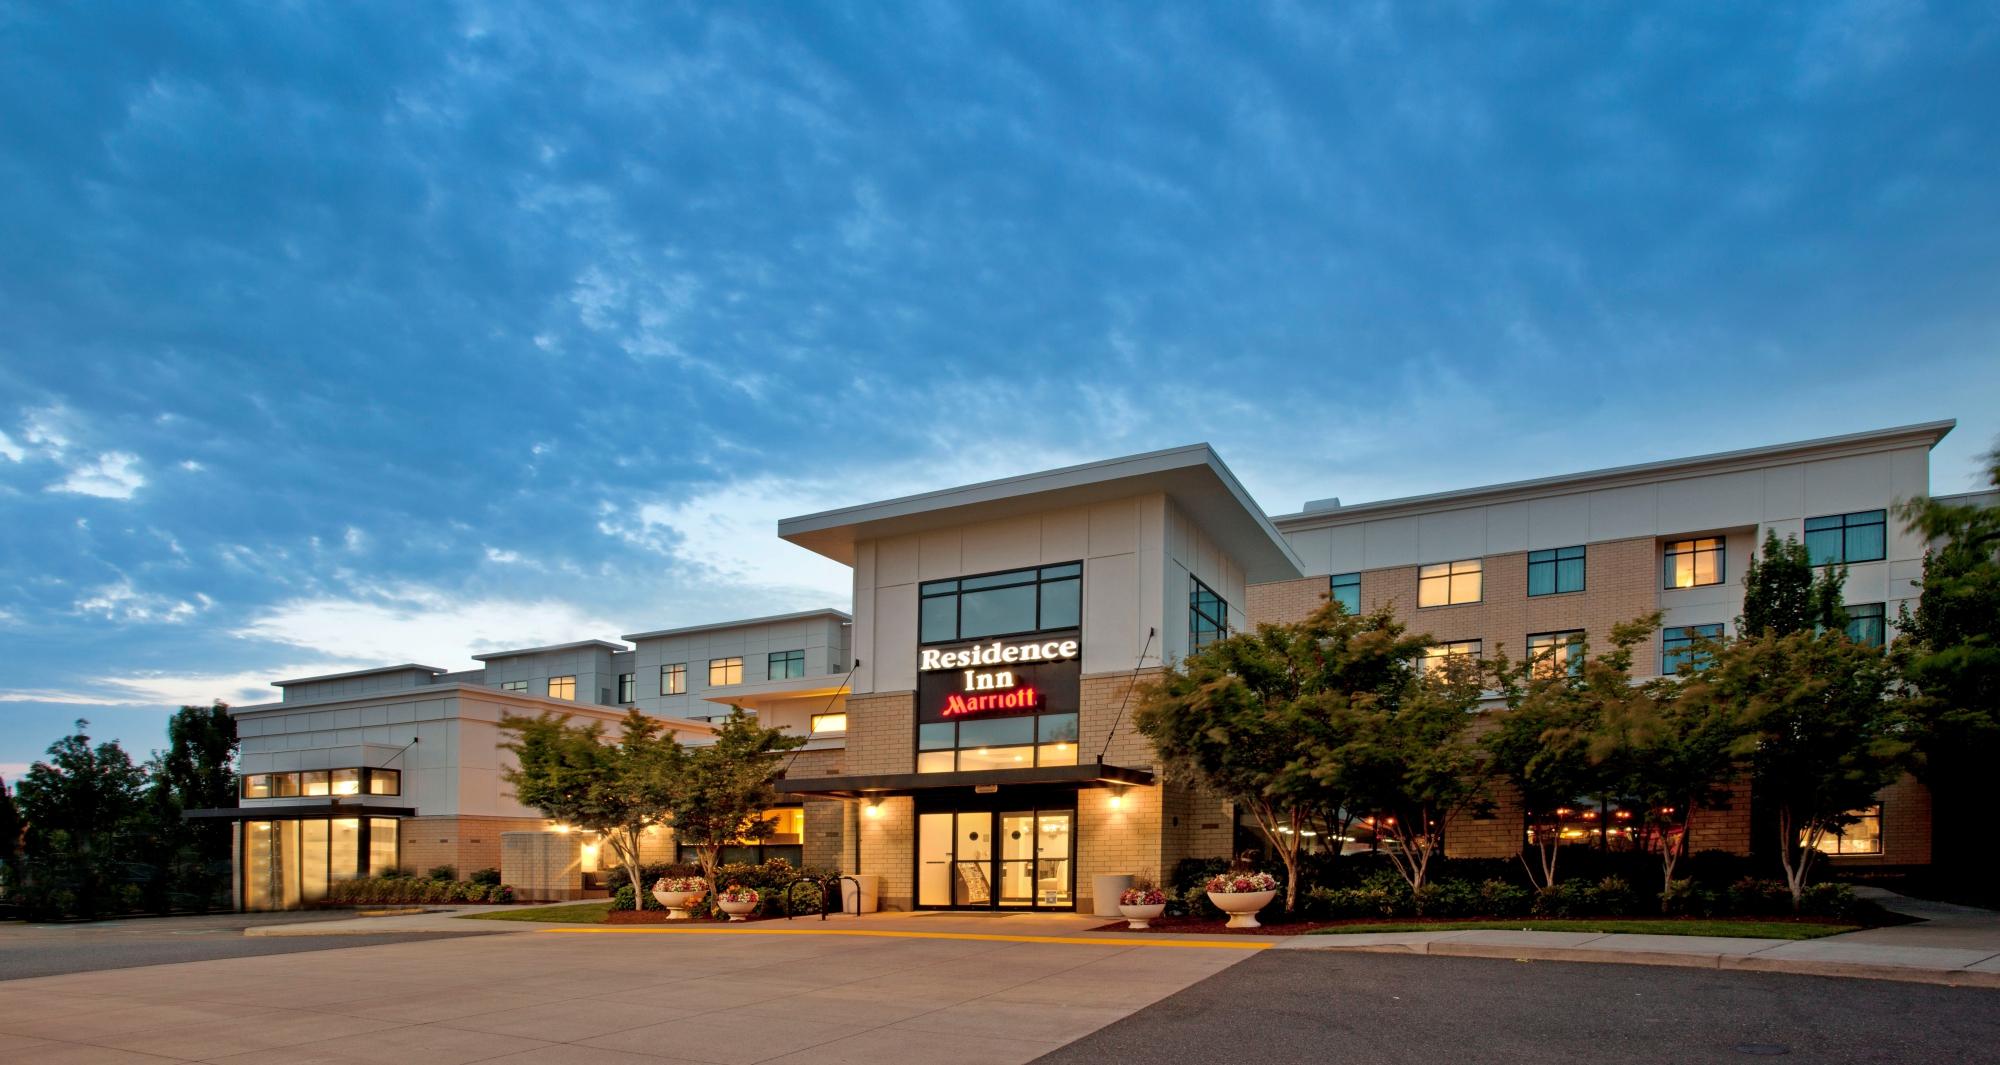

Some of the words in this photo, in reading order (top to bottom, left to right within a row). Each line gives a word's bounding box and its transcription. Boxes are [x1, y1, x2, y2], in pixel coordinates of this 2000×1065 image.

[920, 640, 1077, 670] Residence
[964, 669, 1014, 691] Inn
[942, 687, 1035, 716] Marriott
